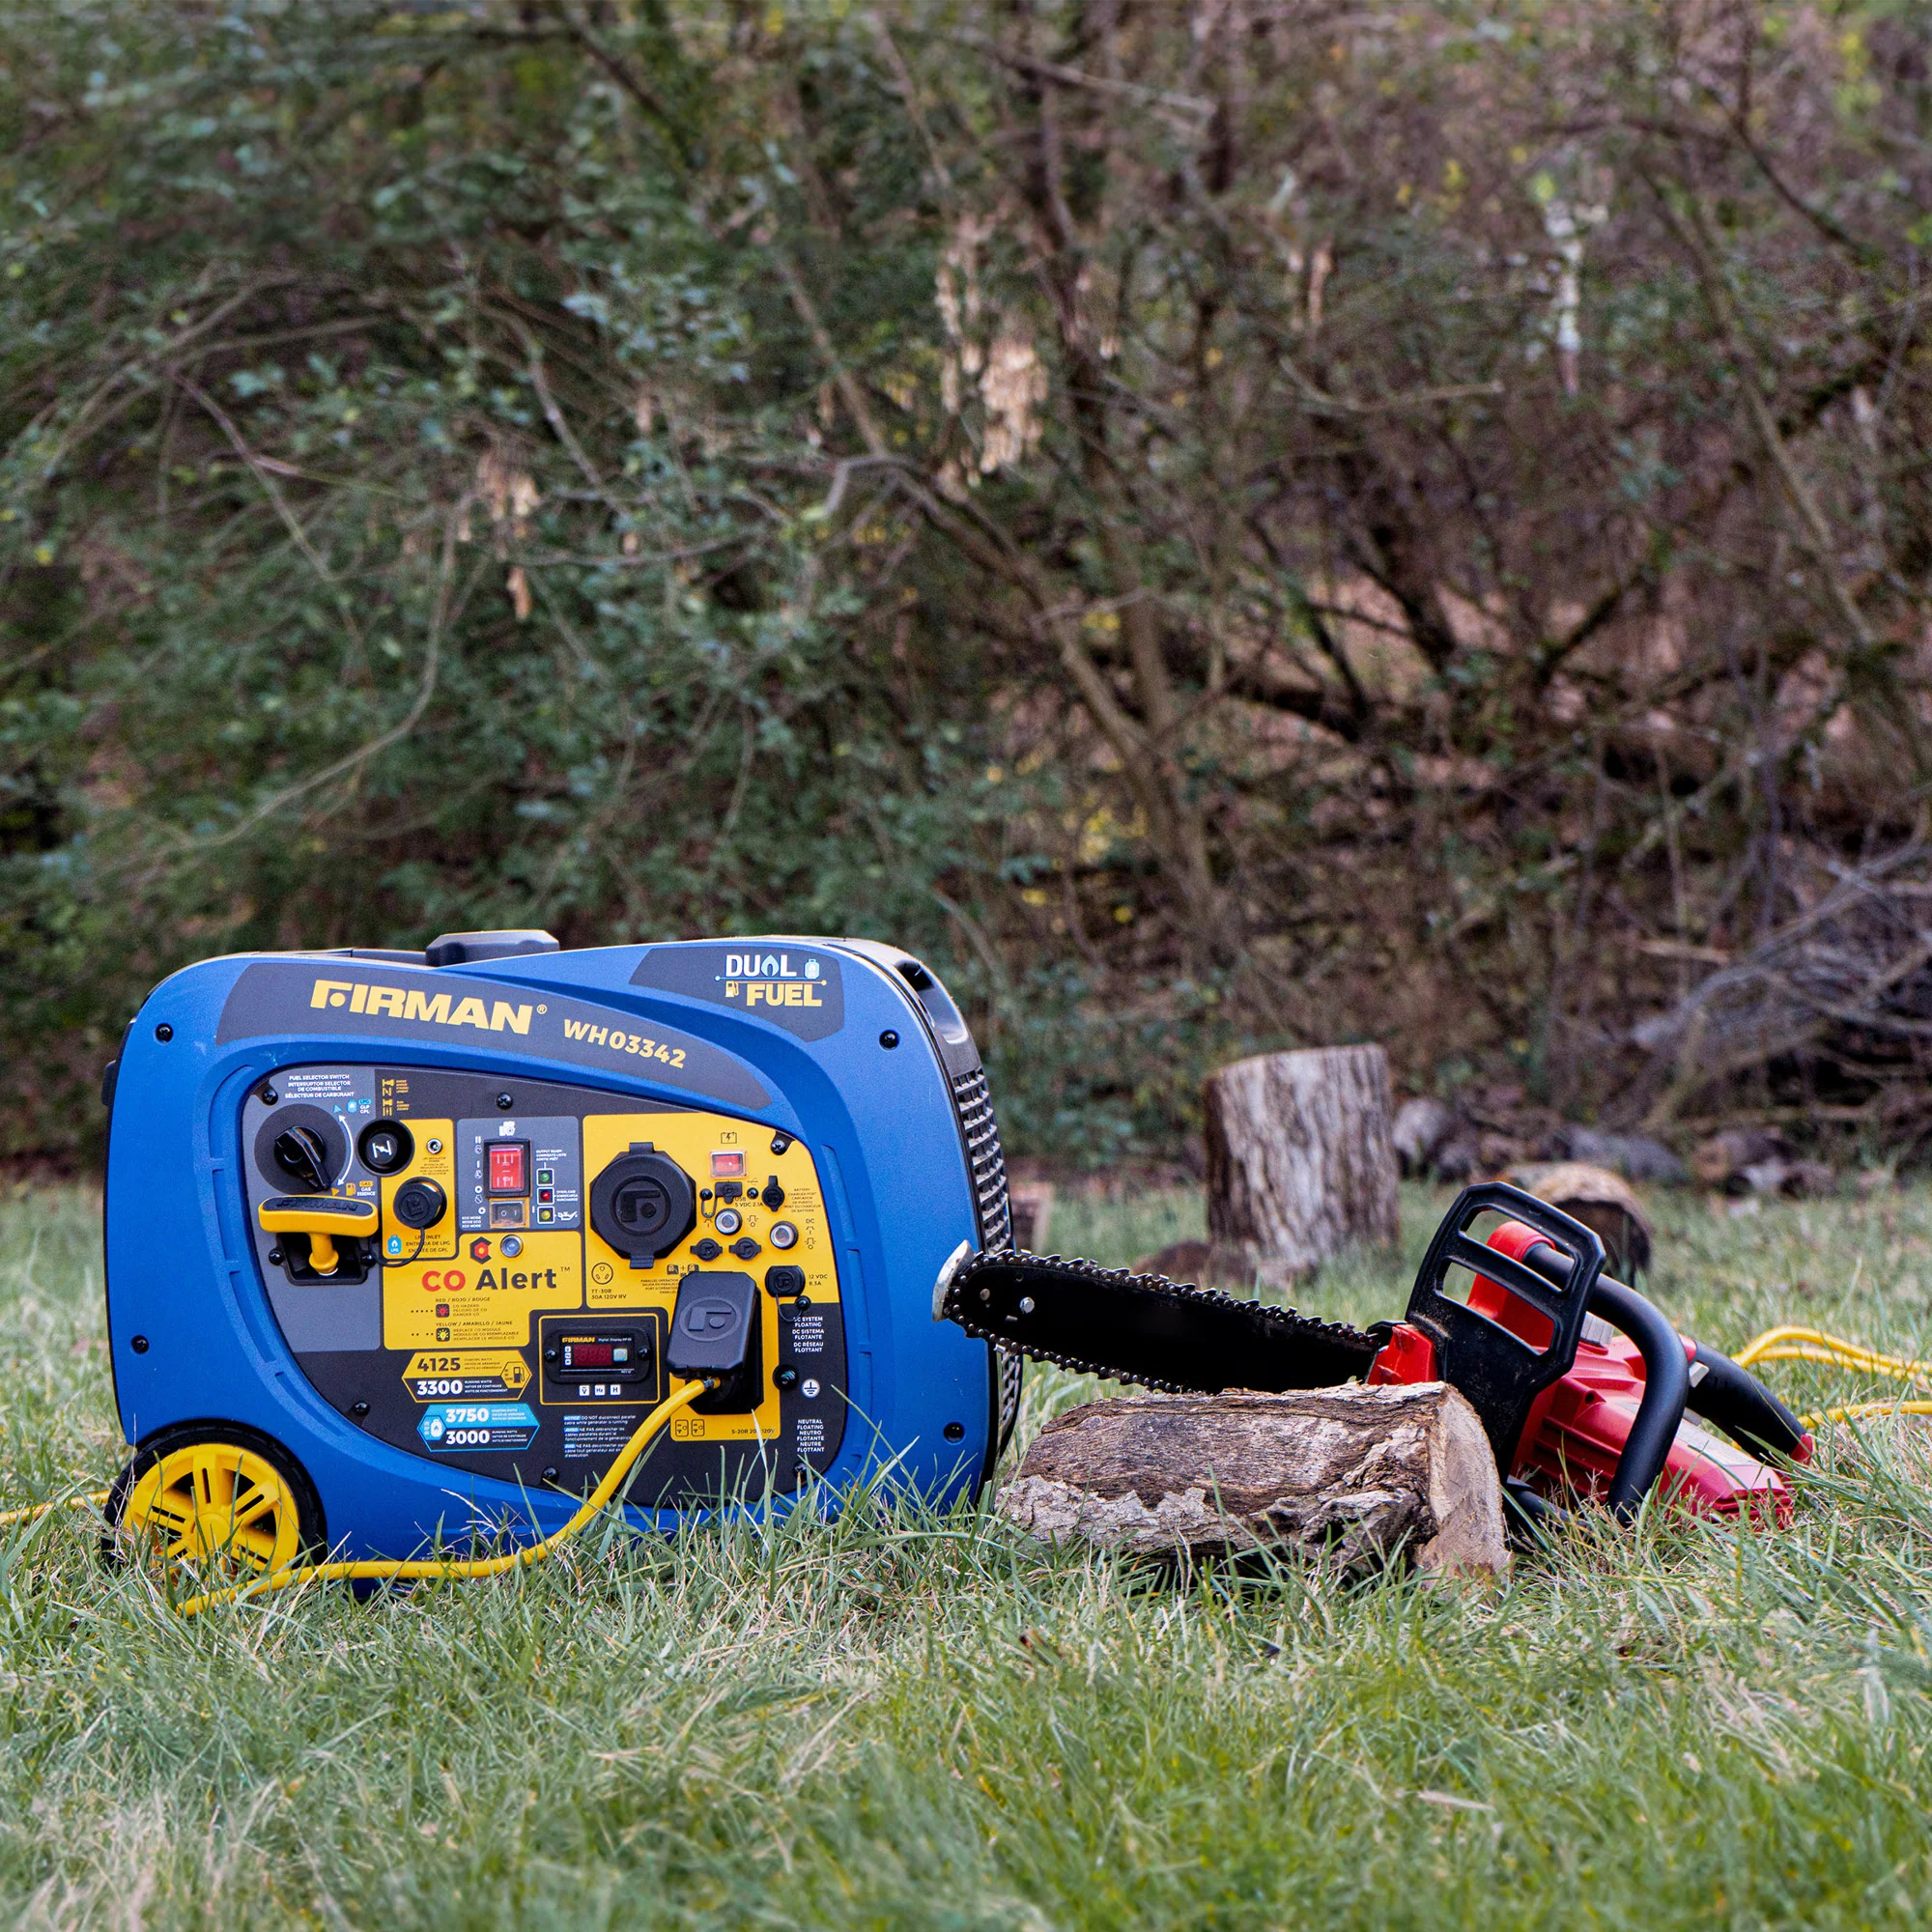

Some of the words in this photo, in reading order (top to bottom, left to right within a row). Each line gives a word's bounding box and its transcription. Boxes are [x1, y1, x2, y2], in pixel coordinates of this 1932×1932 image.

[746, 983, 823, 1007] FUEL
[563, 1019, 686, 1069] WH03342
[421, 1269, 466, 1293] CO
[416, 1357, 461, 1372] 4125
[416, 1379, 463, 1396] 3300
[445, 1407, 490, 1423] 3750
[445, 1430, 491, 1445] 3000
